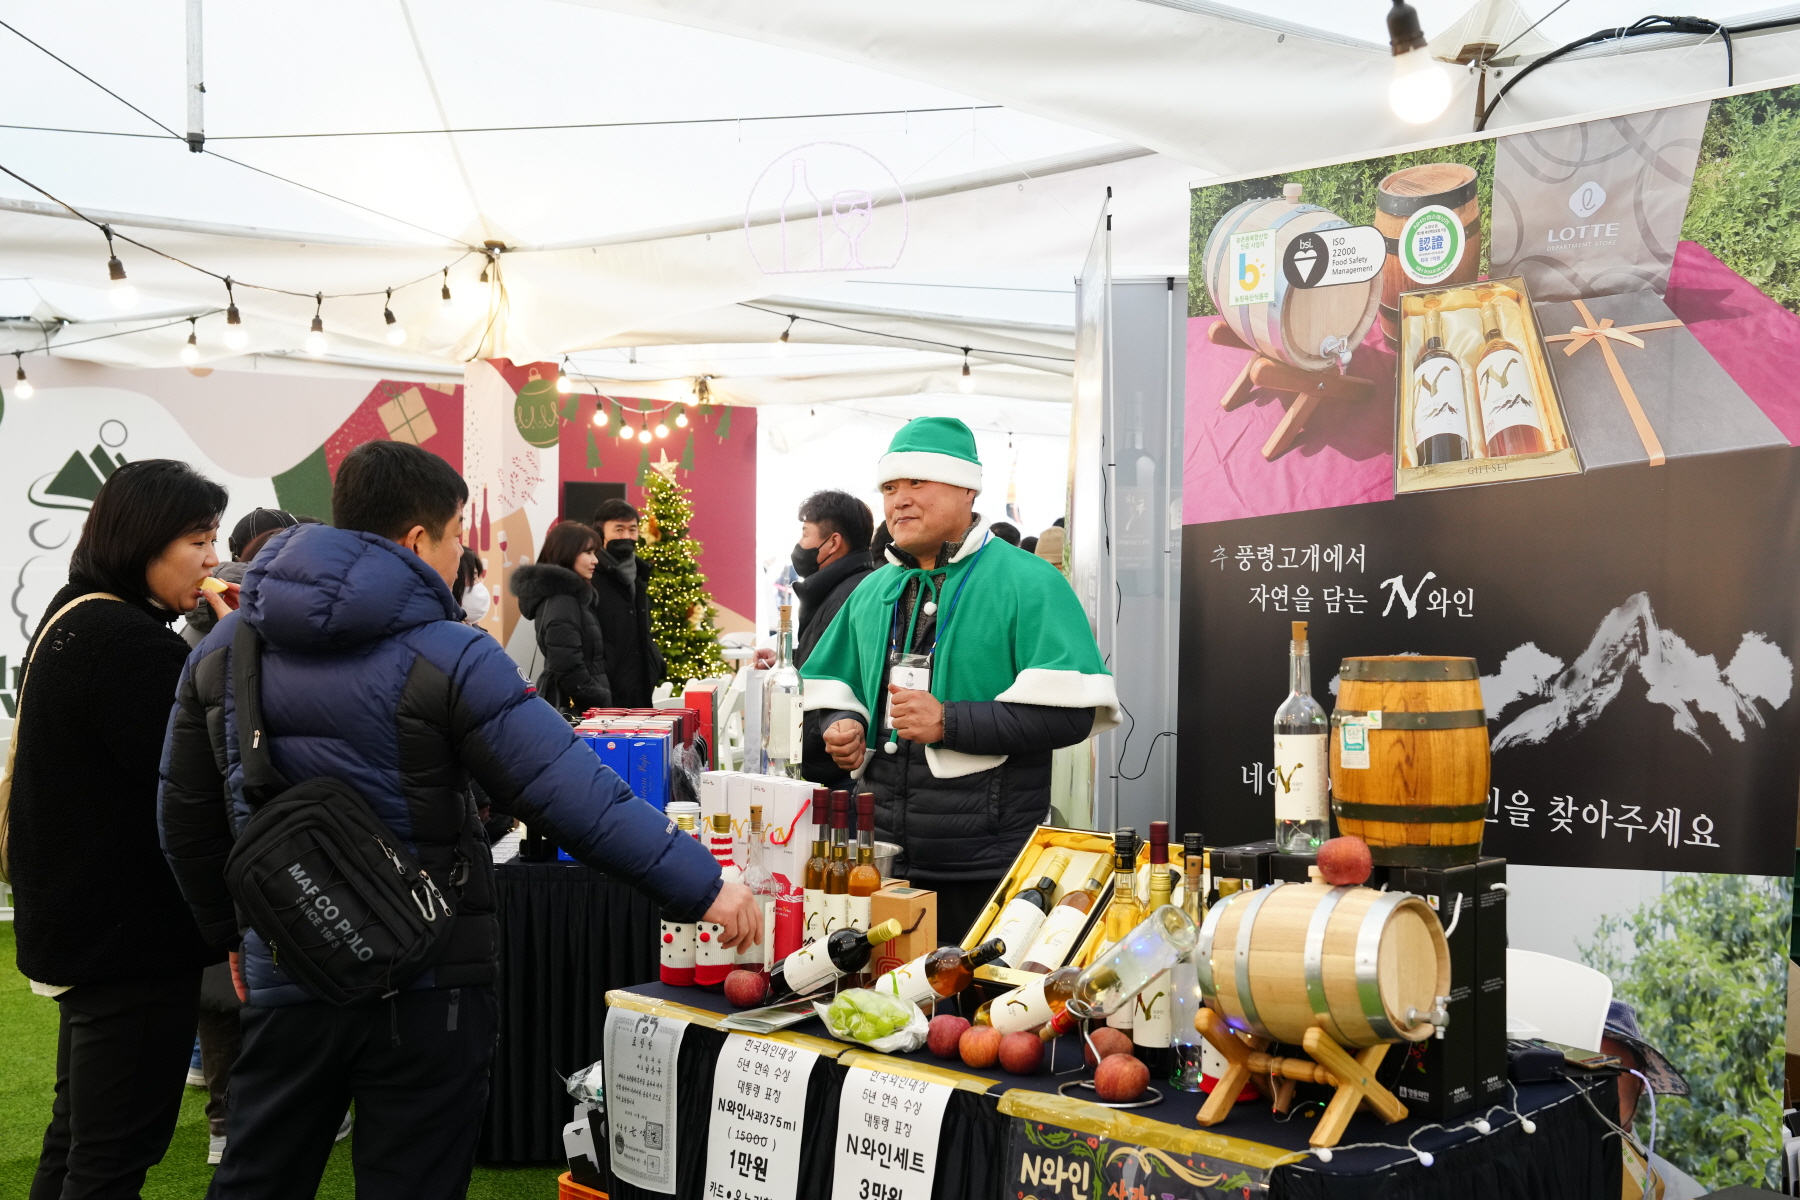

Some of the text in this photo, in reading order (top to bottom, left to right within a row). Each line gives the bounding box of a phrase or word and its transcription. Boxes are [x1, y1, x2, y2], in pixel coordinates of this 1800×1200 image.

[1332, 237, 1346, 247] ISO
[1418, 235, 1444, 252] 認證
[1546, 239, 1617, 252] DEPARTMENT STORE
[1547, 223, 1619, 242] LOTTE
[1332, 247, 1356, 257] 22000
[1332, 256, 1368, 267] Food Safety
[1331, 265, 1373, 276] Management
[1249, 583, 1314, 613] 자연을
[1322, 585, 1368, 614] 담는
[1547, 795, 1721, 849] 찾아주세요
[295, 896, 324, 928] SINCE
[333, 918, 374, 962] POLO
[745, 1038, 798, 1062] 한국와인대상
[736, 1057, 791, 1083] 5년 연속 수상
[737, 1079, 781, 1104] 대통령 표창
[862, 1088, 923, 1116] 5년 연속 수상
[864, 1112, 913, 1138] 대통령 표창
[729, 1149, 769, 1183] 1만원
[846, 1133, 925, 1174] N와인세트
[1020, 1152, 1089, 1200] N와인
